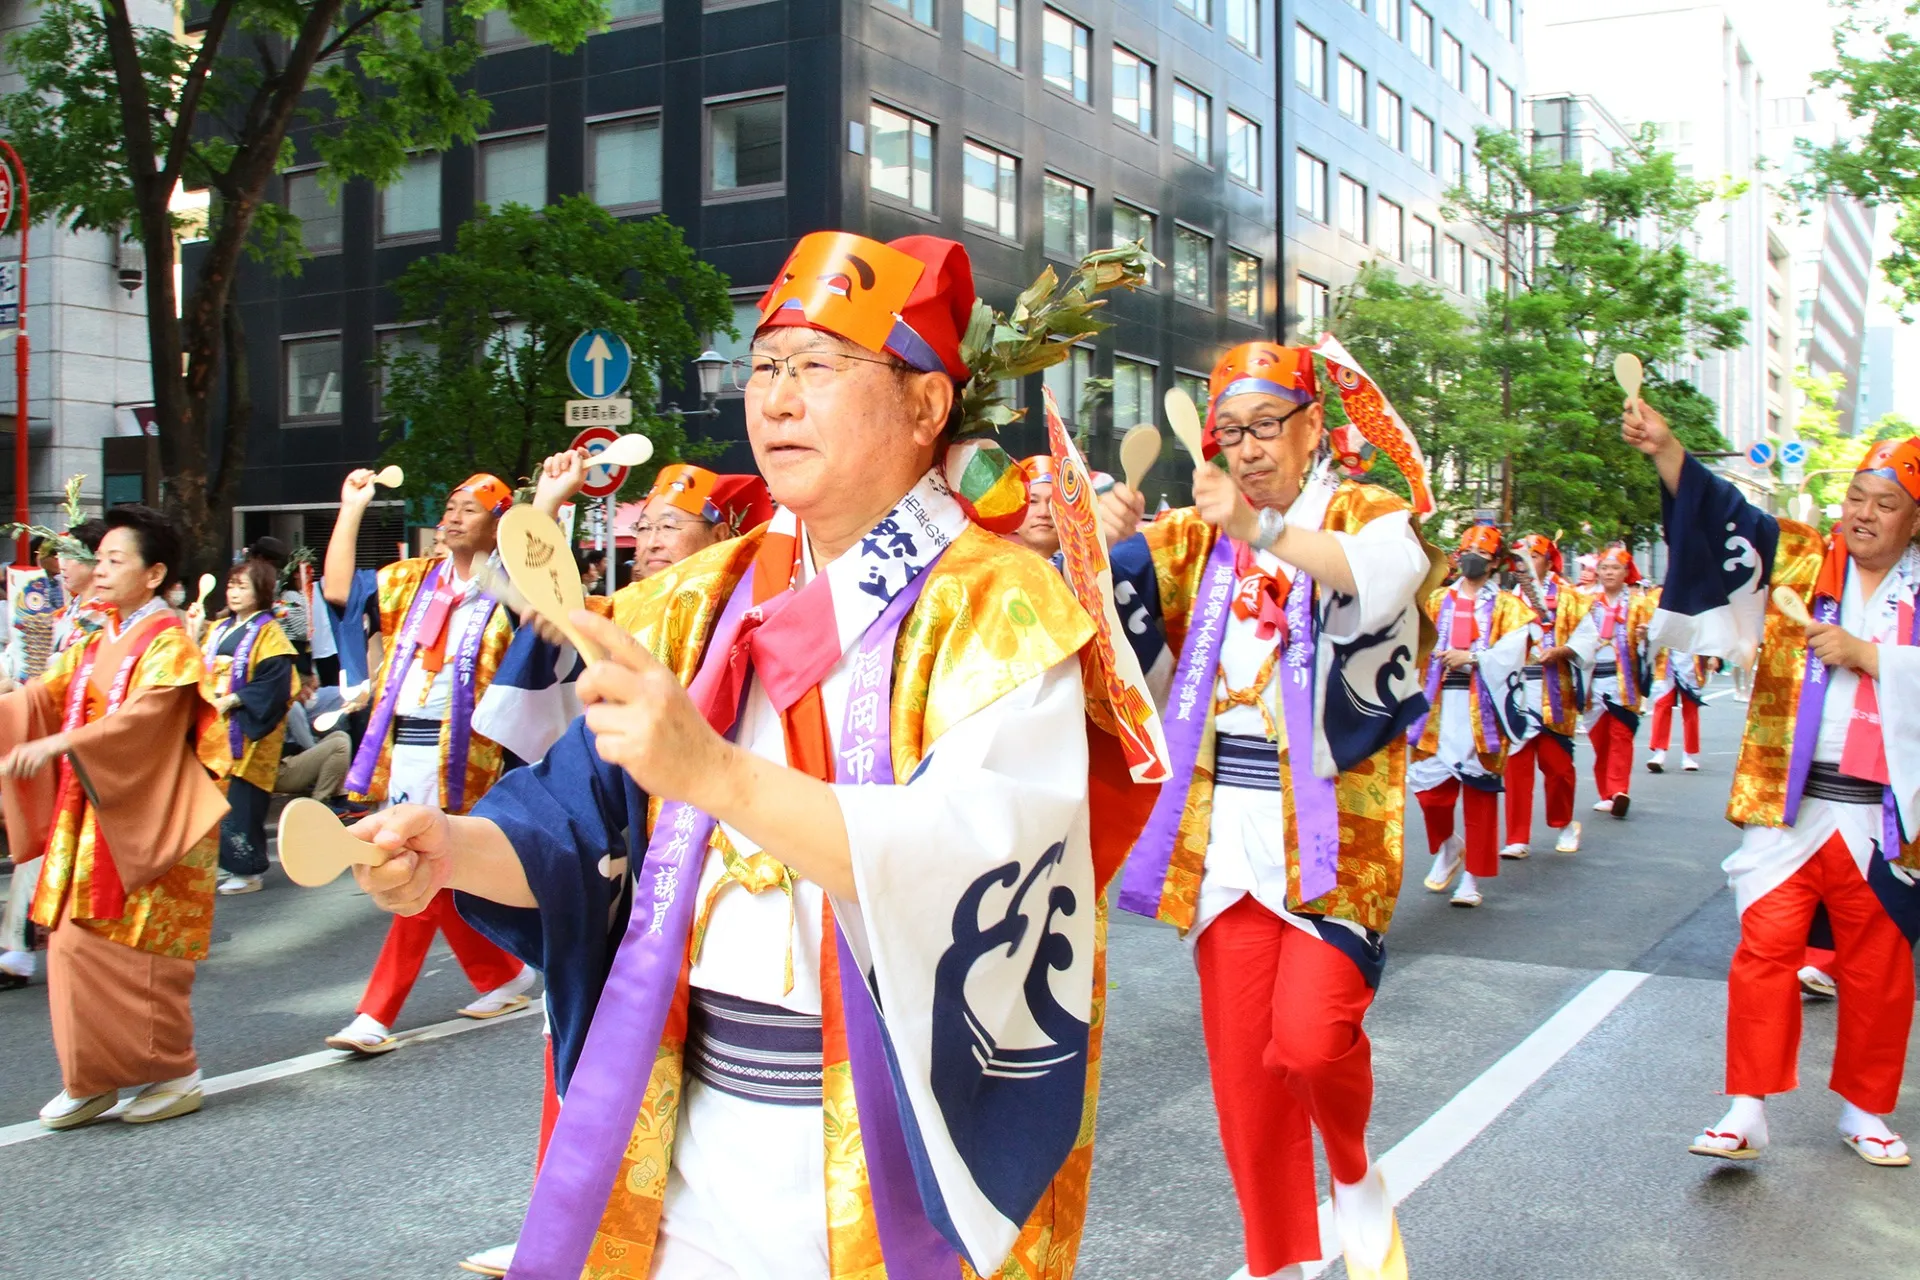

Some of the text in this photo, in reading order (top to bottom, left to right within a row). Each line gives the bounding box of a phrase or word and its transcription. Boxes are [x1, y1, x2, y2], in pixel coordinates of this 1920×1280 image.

[839, 644, 885, 786] 福岡市
[647, 802, 698, 936] 議所議員
